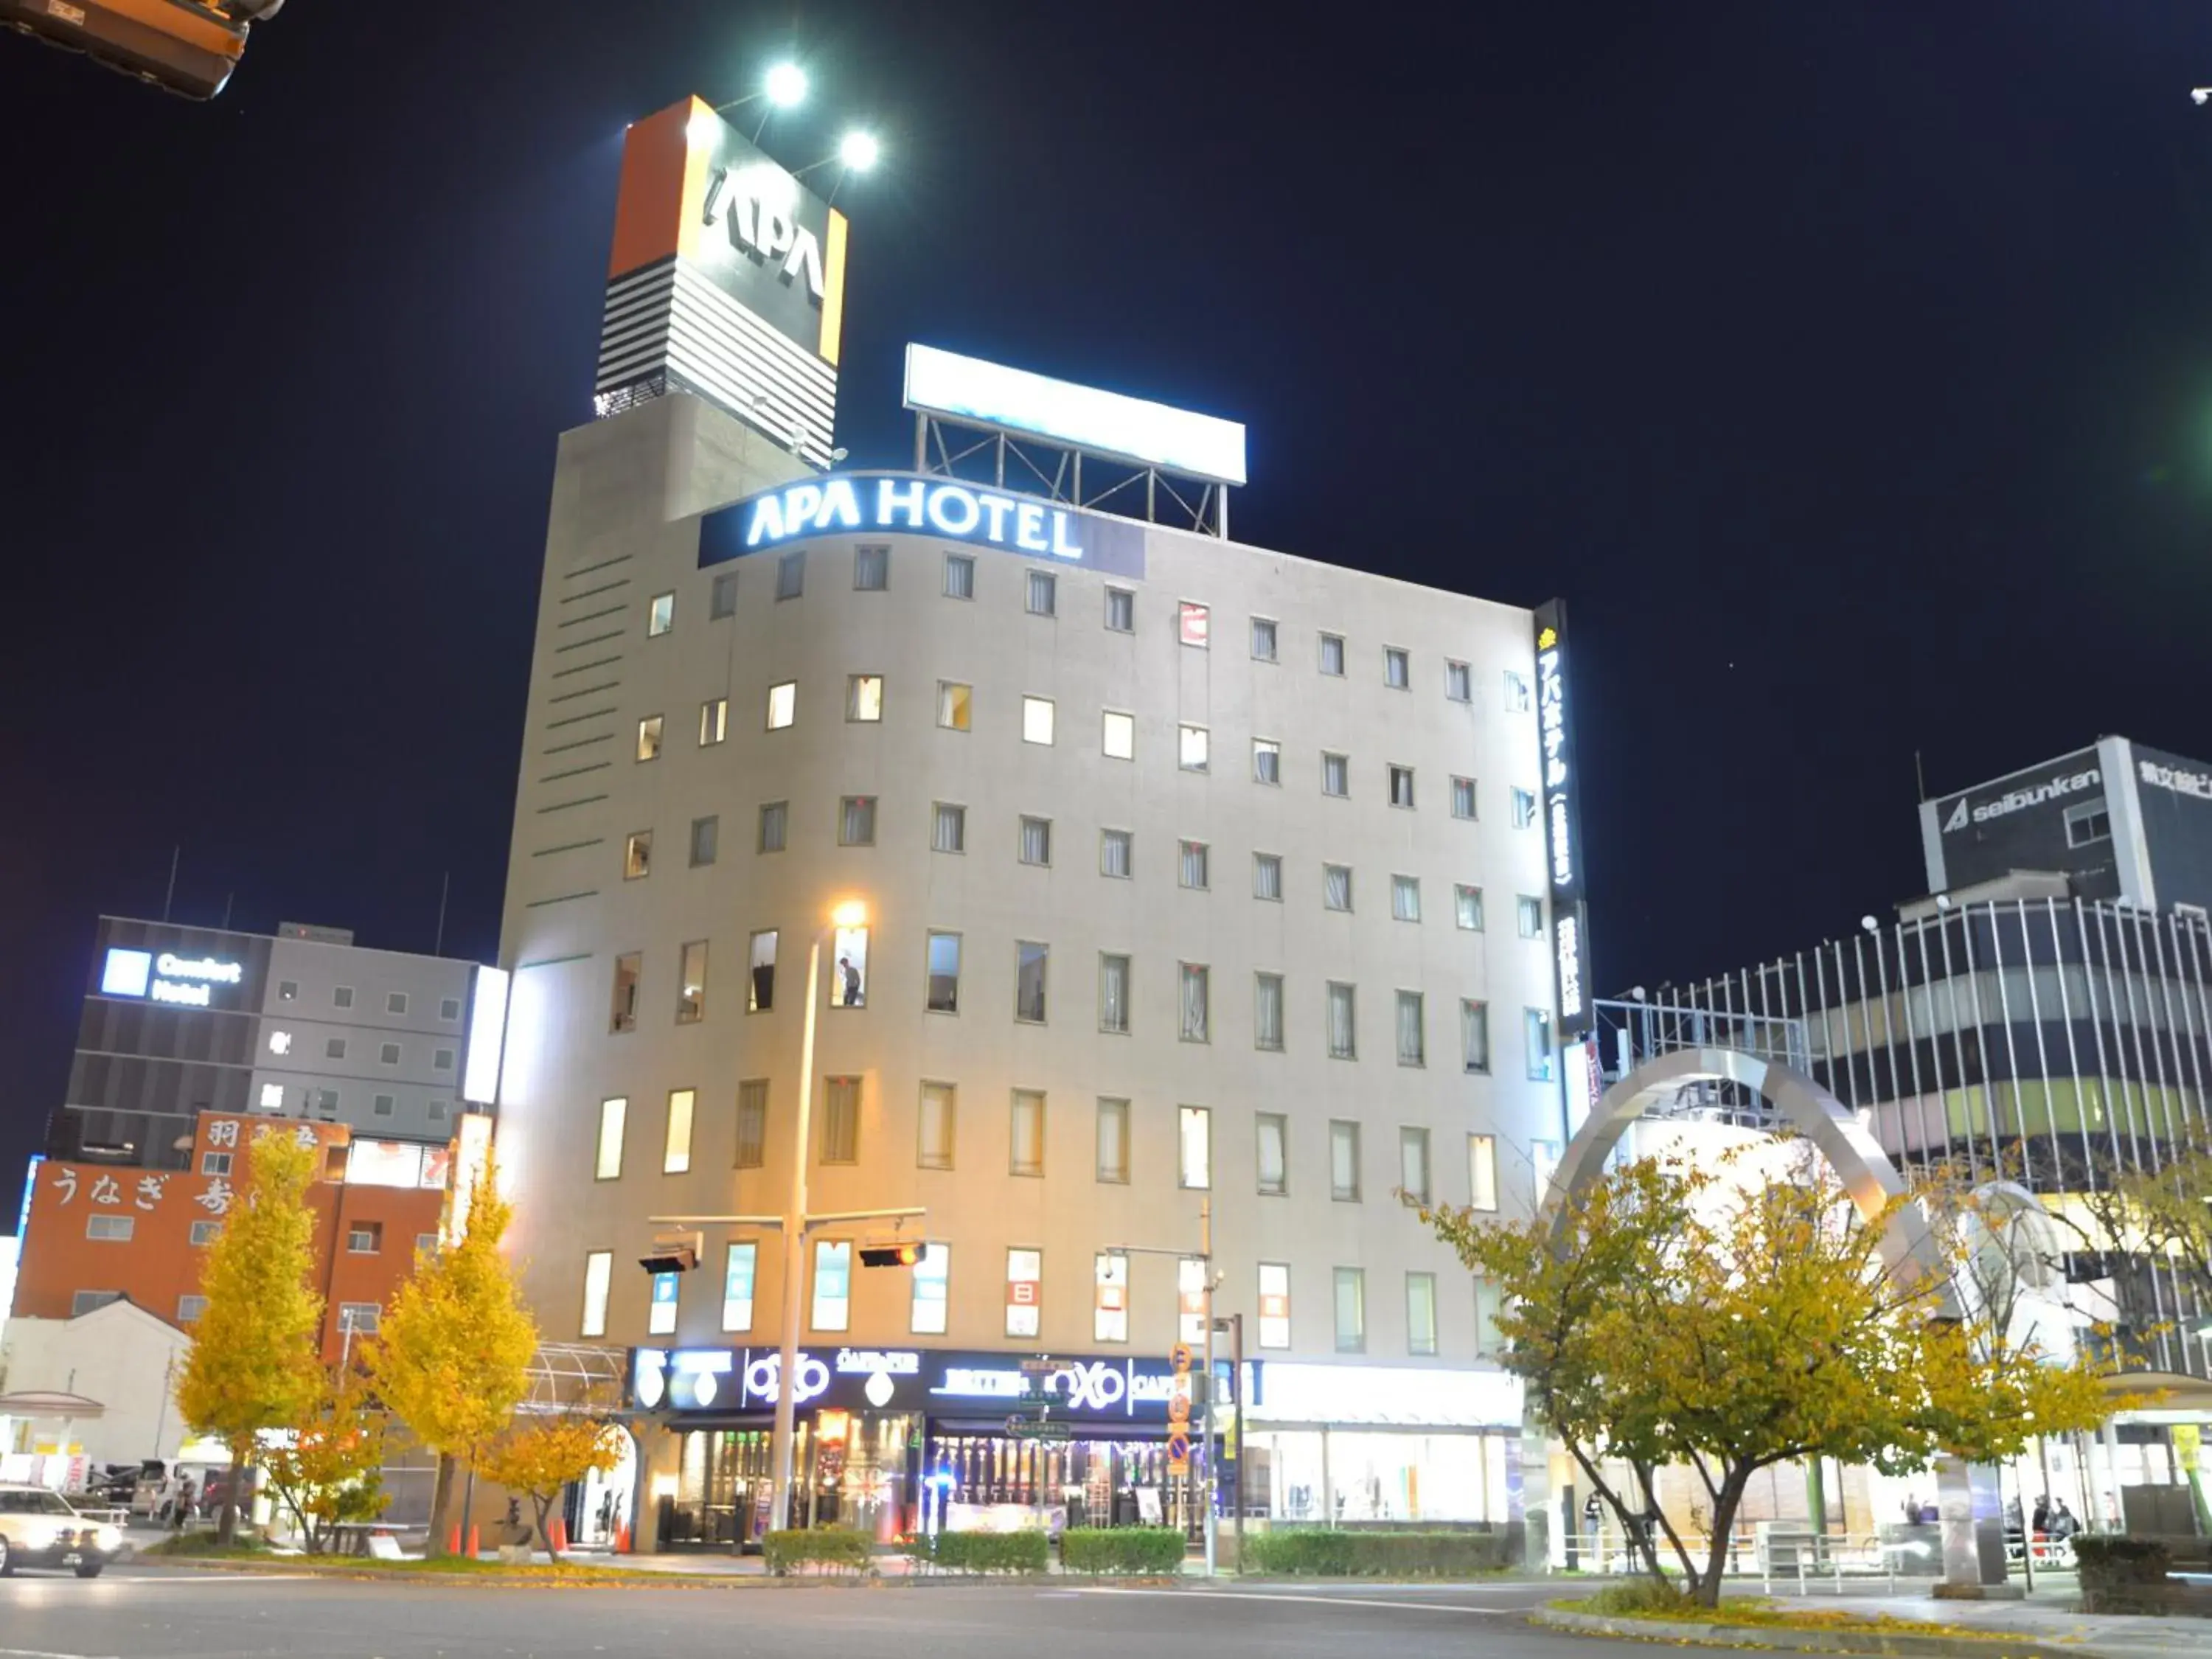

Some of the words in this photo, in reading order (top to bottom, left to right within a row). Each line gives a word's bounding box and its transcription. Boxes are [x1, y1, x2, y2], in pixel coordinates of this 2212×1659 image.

[706, 165, 824, 301] APA
[746, 479, 860, 546] APA
[875, 479, 1083, 559] HOTEL
[1972, 768, 2100, 823] seibunkan
[52, 1167, 170, 1211] うなぎ
